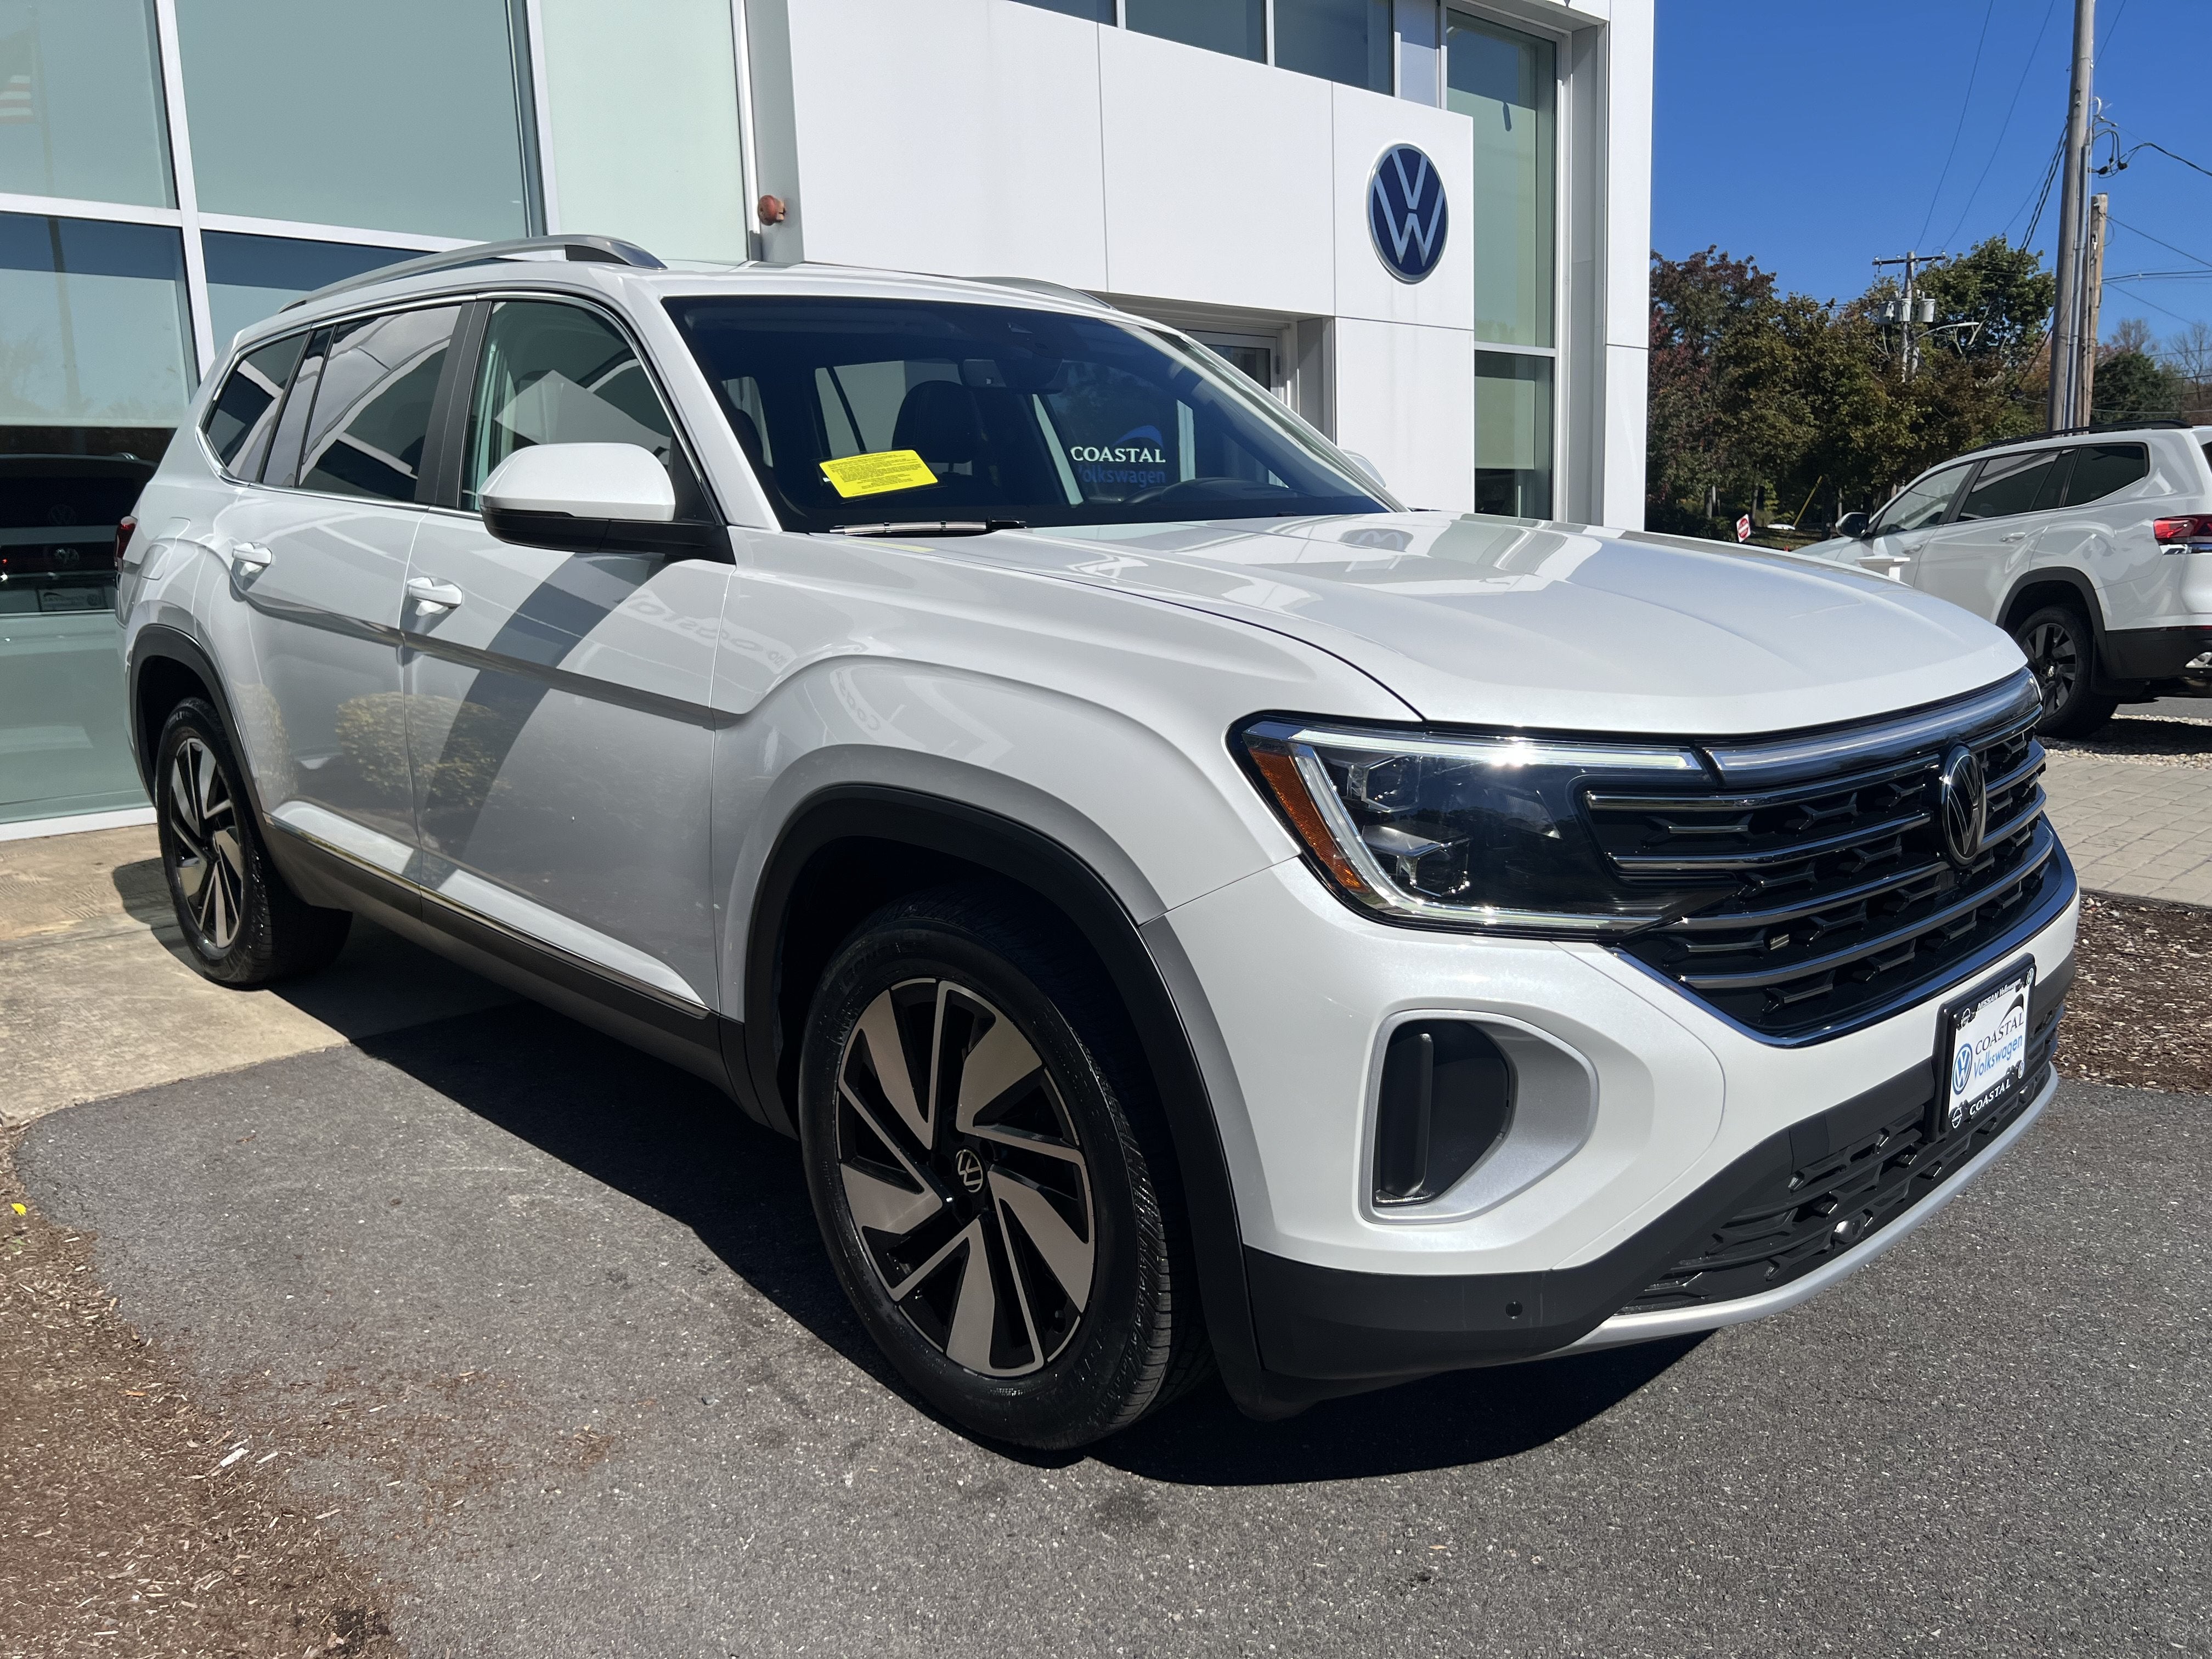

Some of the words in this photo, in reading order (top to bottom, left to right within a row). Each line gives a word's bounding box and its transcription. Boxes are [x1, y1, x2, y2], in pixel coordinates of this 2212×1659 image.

[1371, 146, 1447, 272] VW
[1070, 446, 1166, 463] COASTAL
[1976, 1012, 2024, 1055] COASTAL
[1953, 1045, 1972, 1094] VW
[1974, 1035, 2023, 1079] Volkswagen
[1969, 1079, 2011, 1116] COASTAL
[956, 1149, 984, 1193] VW
